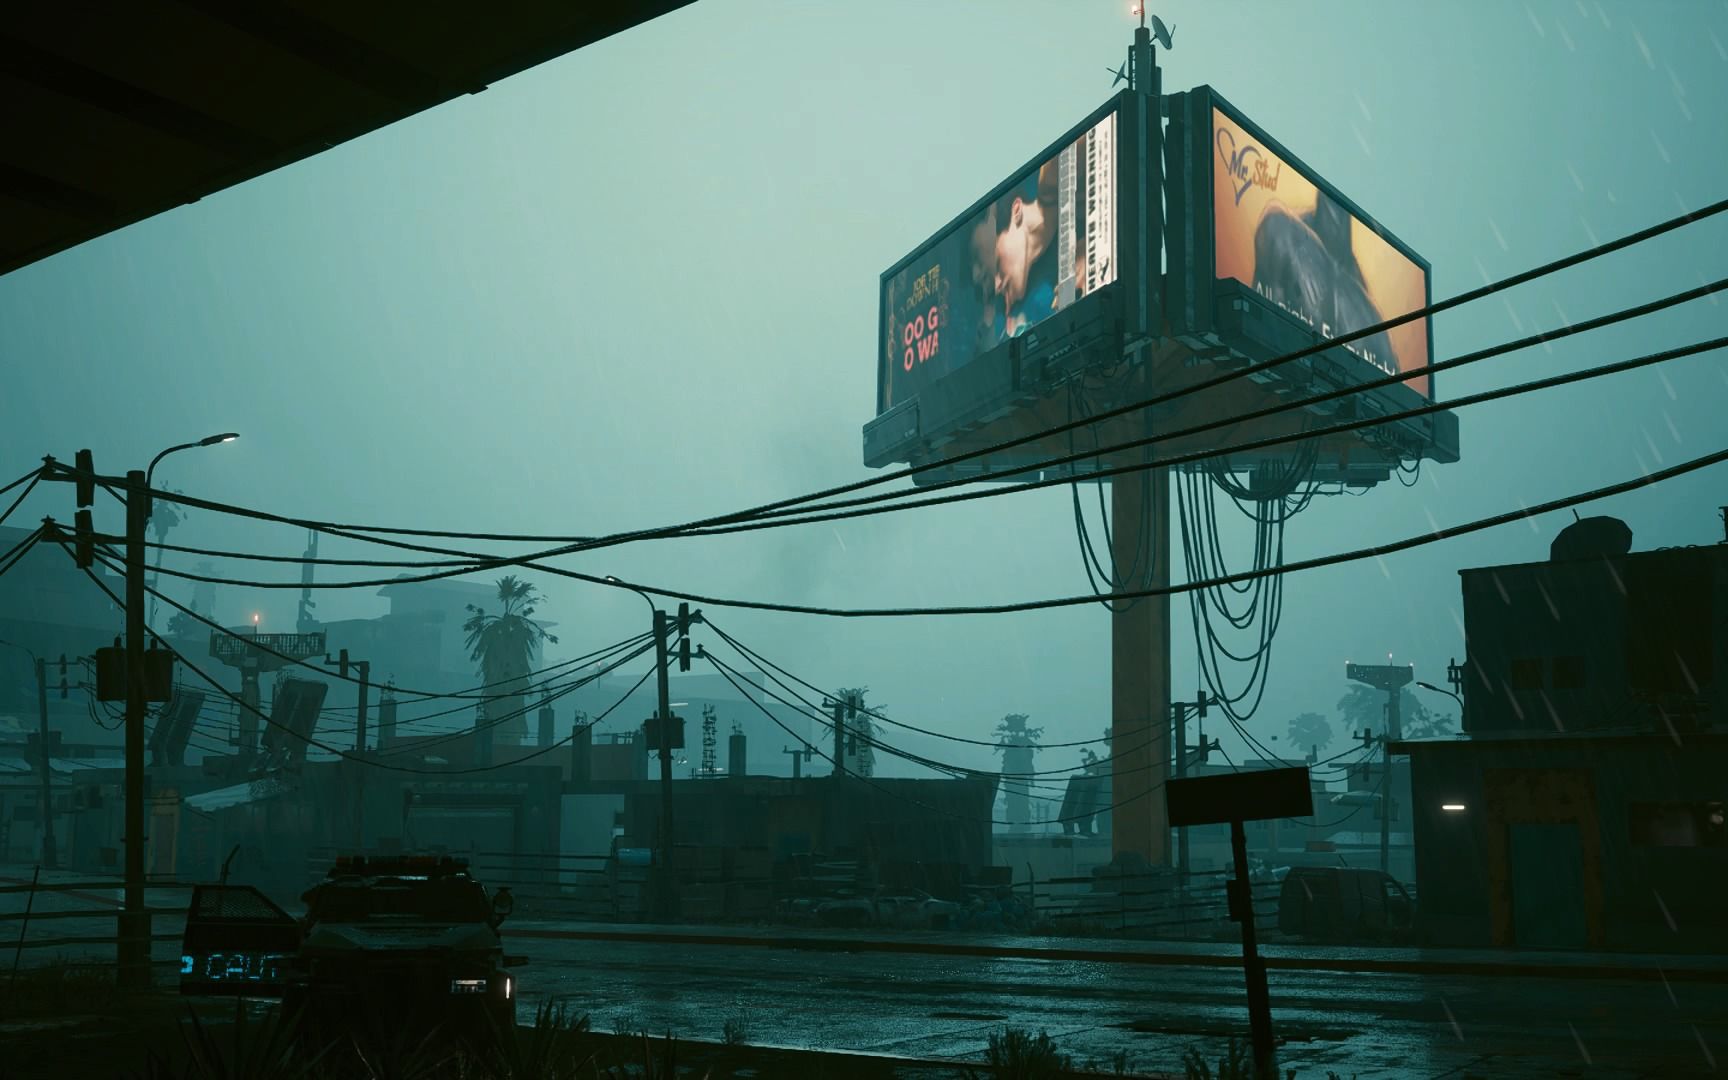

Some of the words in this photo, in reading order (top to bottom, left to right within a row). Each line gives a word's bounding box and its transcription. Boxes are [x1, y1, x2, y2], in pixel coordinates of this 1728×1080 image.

[1087, 127, 1097, 216] WARNING
[1252, 158, 1281, 192] Stud
[1087, 220, 1097, 290] HEALTH
[917, 331, 939, 363] WA
